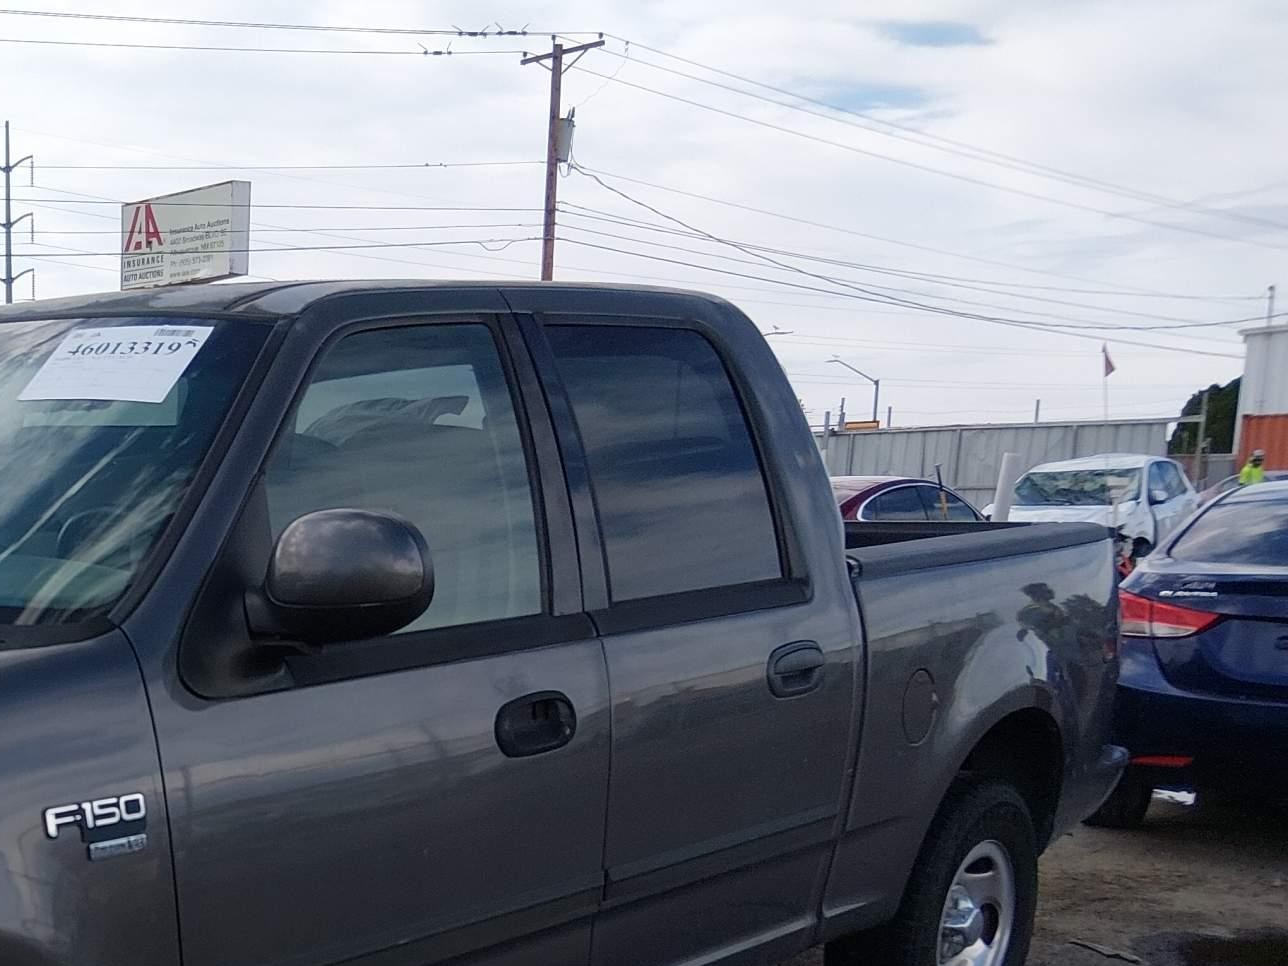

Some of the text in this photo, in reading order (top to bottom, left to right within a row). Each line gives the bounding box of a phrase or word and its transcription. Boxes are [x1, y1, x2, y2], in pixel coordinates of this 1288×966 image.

[123, 256, 164, 269] INSURANCE
[123, 272, 138, 282] AUTO
[138, 269, 164, 280] AUCTIONS
